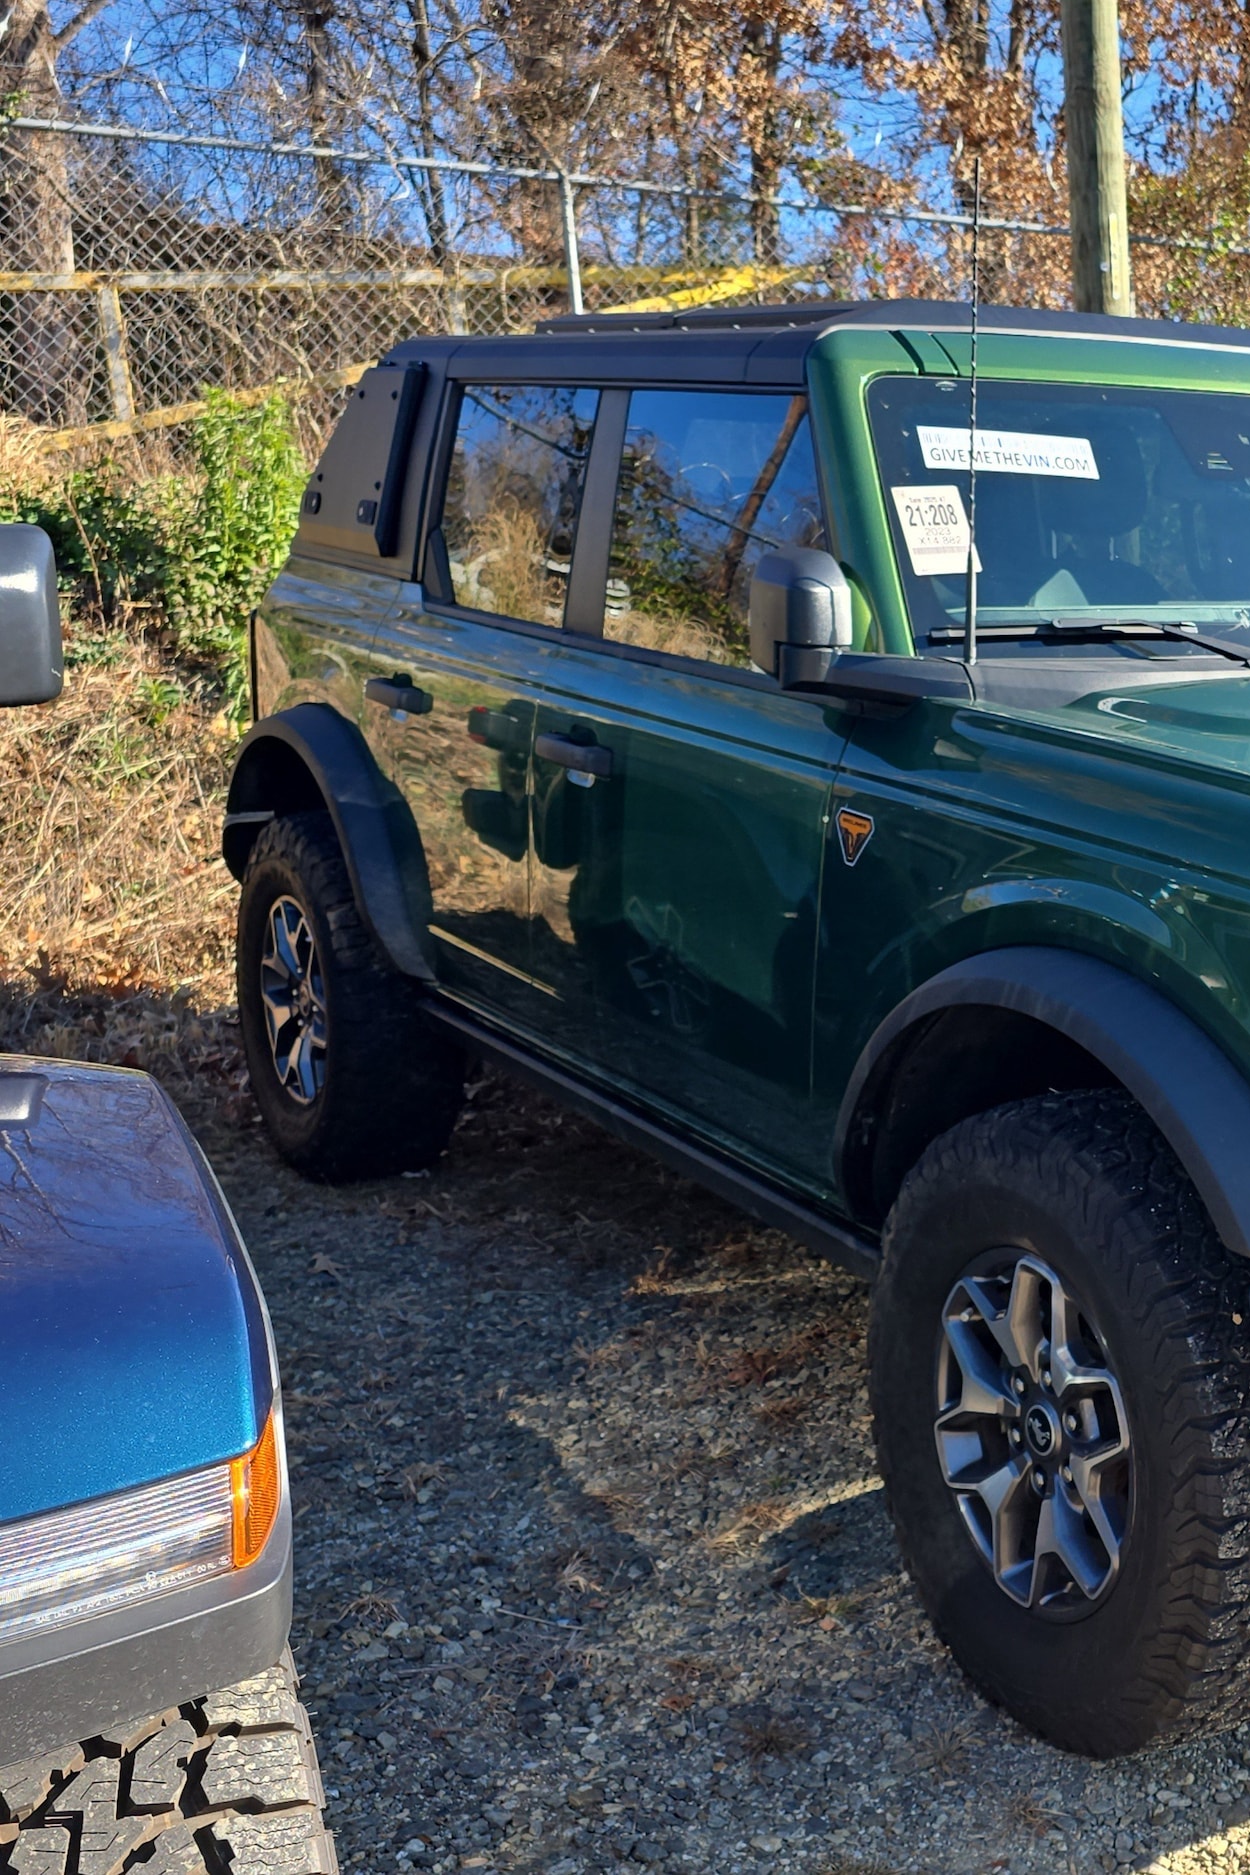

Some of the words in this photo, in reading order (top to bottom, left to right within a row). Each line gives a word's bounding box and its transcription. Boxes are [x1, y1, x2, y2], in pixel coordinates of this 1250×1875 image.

[930, 448, 1090, 472] GIVEMETHEVIN.COM
[905, 504, 958, 527] 21:208
[924, 527, 951, 536] 2023
